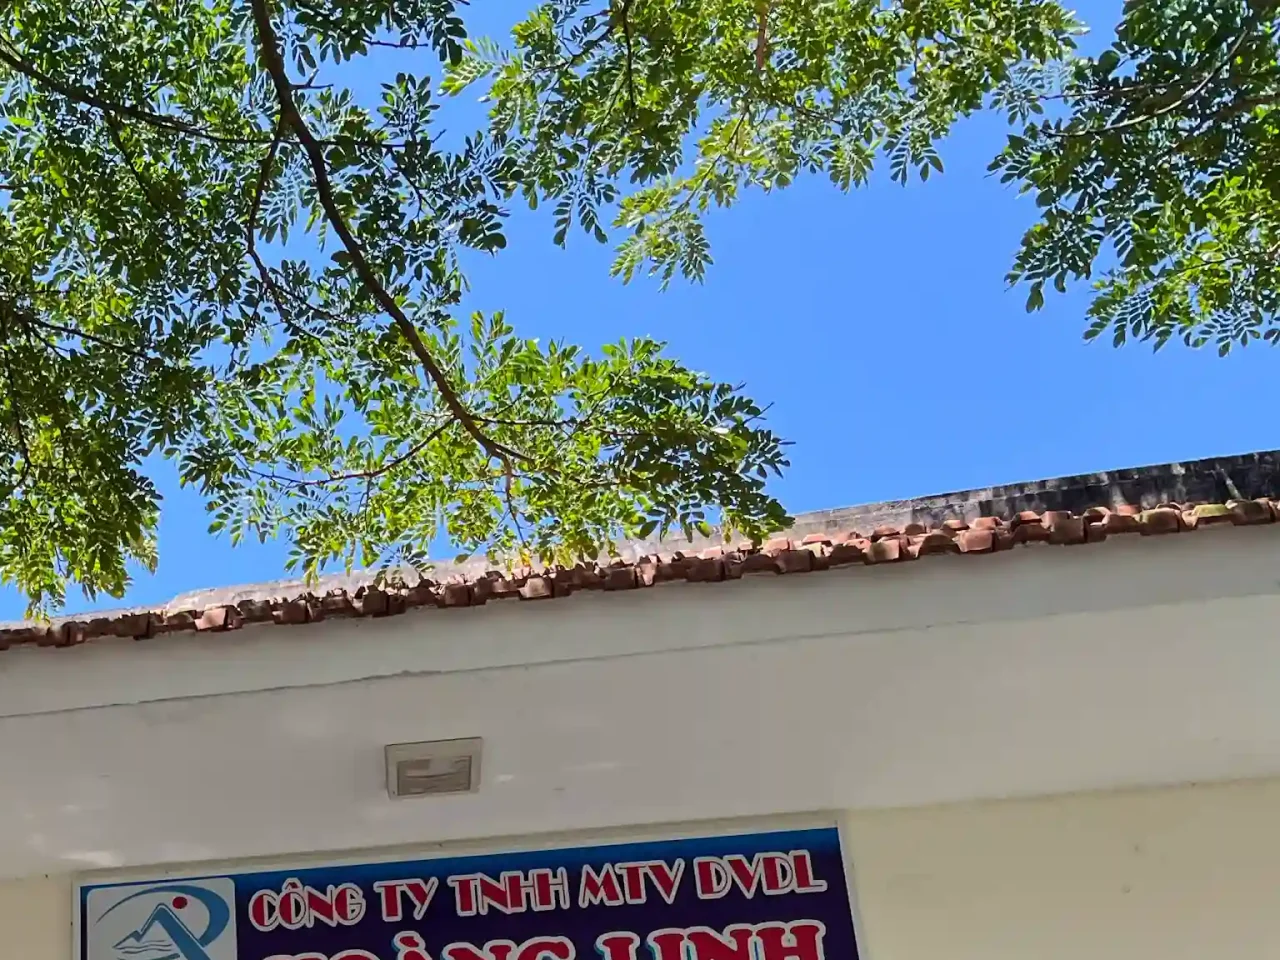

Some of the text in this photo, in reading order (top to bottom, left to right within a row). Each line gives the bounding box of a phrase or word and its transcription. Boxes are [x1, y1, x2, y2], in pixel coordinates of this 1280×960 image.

[248, 849, 827, 932] CÔNG TY TNHH MTV DVDL
